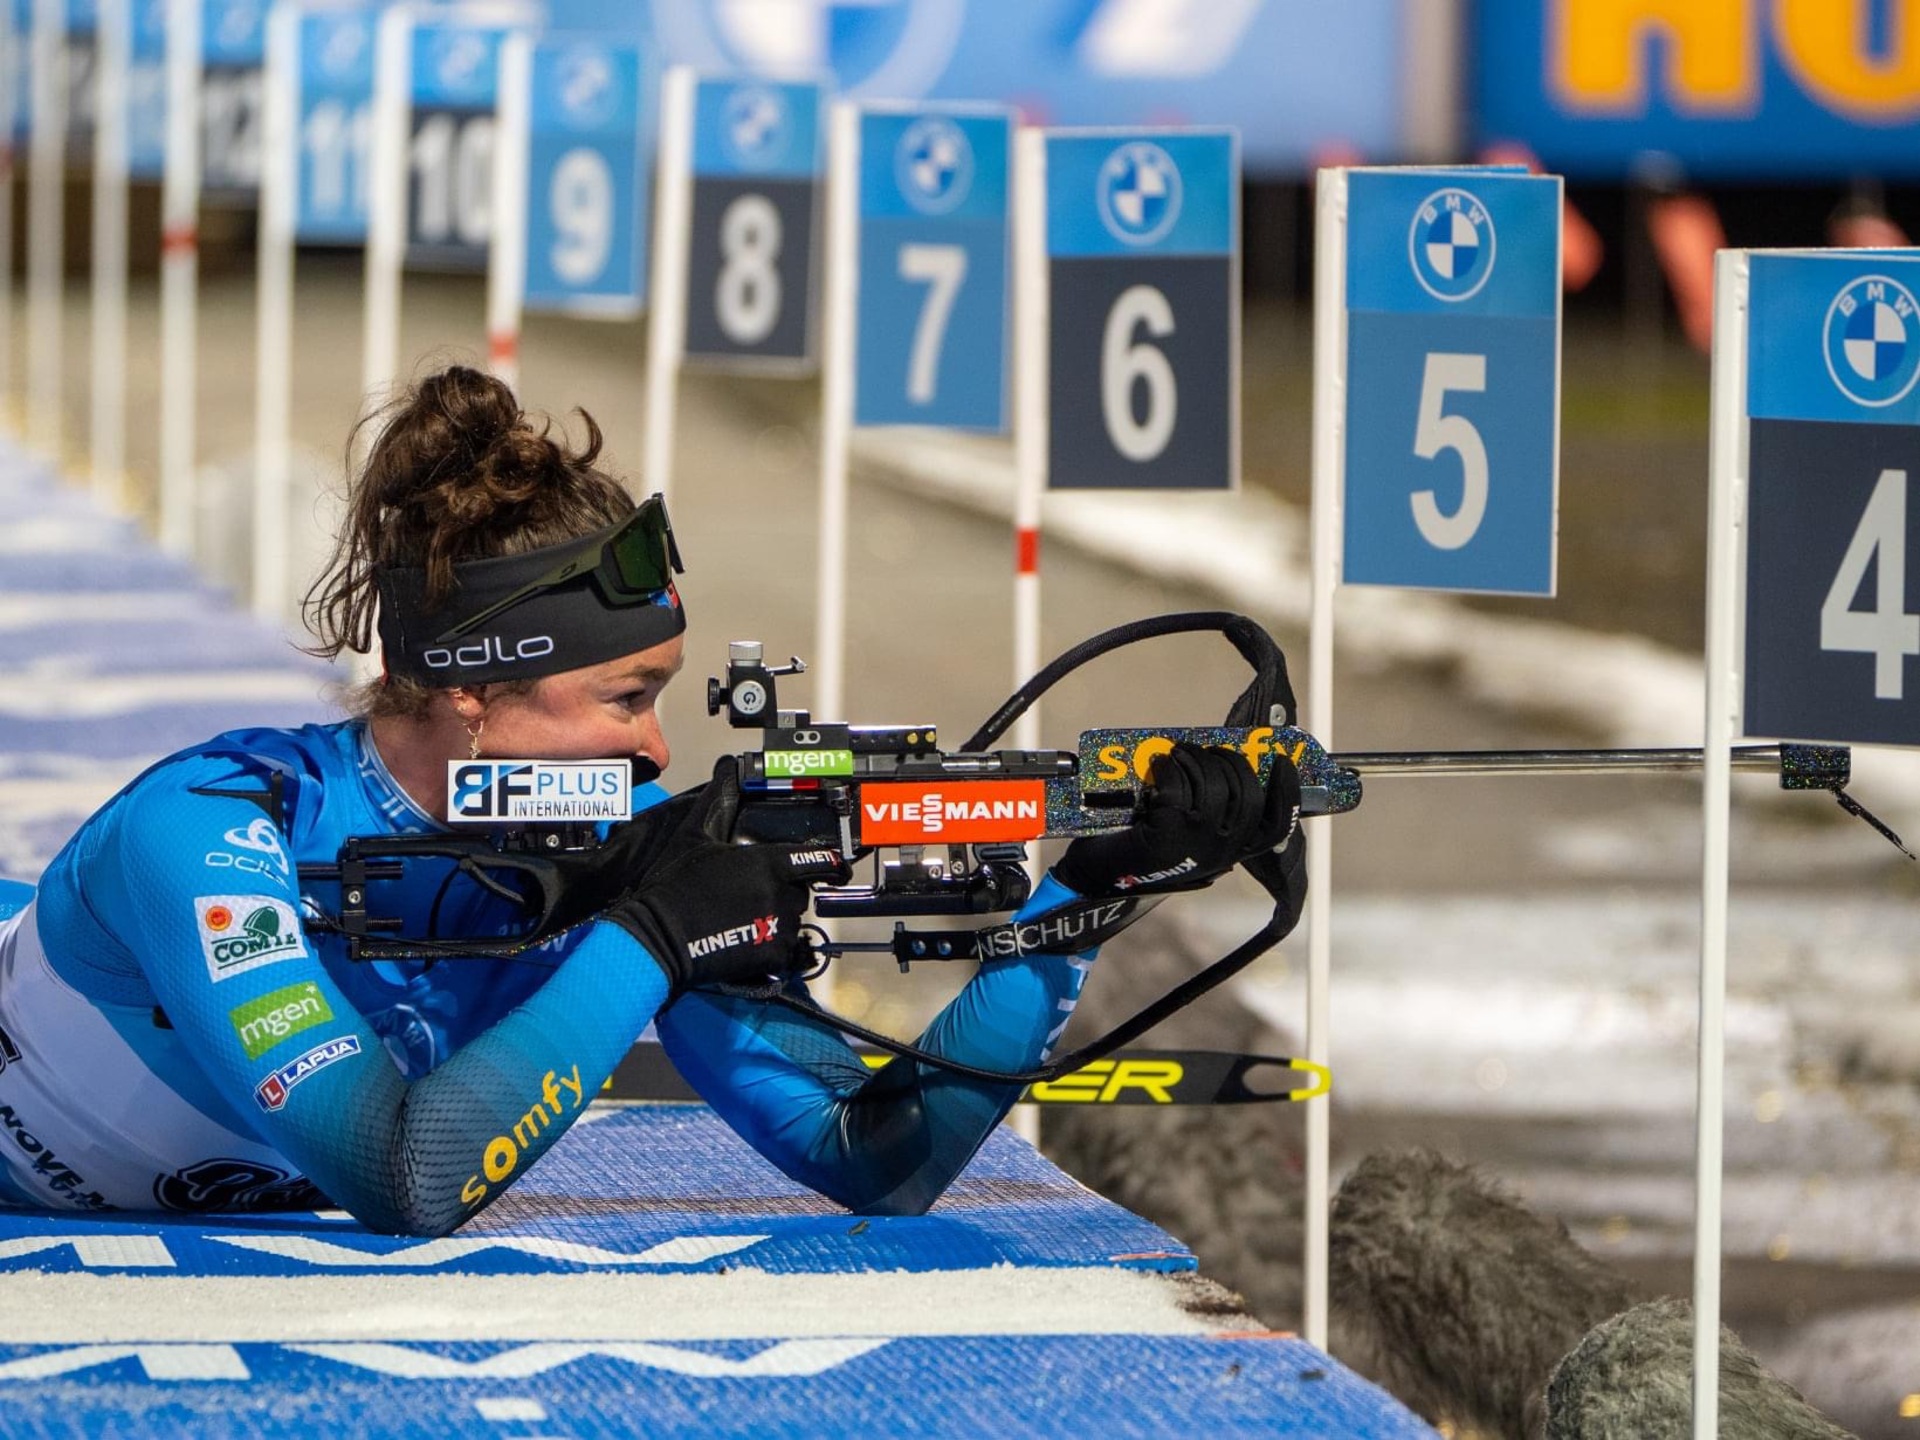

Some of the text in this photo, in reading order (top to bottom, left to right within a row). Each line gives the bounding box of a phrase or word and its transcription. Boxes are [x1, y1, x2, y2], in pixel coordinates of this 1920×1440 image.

[551, 148, 614, 284] 9
[715, 194, 782, 344] 8
[899, 245, 967, 404] 7
[1839, 282, 1914, 318] BMW
[1101, 284, 1178, 462] 6
[1409, 352, 1489, 550] 5
[1820, 469, 1920, 699] 4
[423, 635, 555, 668] odlo
[537, 772, 619, 796] PLUS
[764, 749, 837, 776] mgen
[513, 801, 620, 817] INTERNATIONAL
[864, 793, 1038, 833] VIESSMANN
[969, 899, 1127, 960] NSCHÜTZ
[240, 997, 321, 1046] mgen
[282, 1042, 355, 1084] LAPUA
[459, 1064, 584, 1208] somfy
